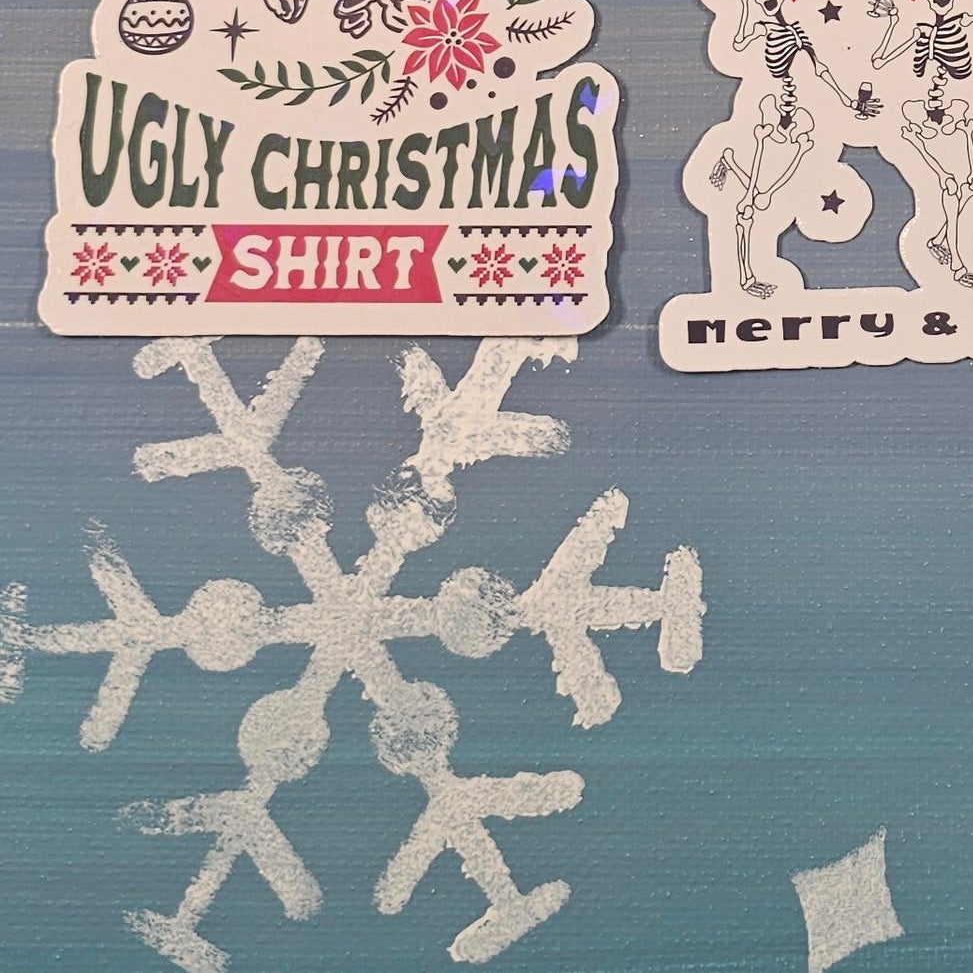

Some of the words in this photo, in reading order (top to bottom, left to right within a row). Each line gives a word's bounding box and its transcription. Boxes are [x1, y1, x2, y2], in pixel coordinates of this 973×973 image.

[80, 72, 234, 209] UGLY
[251, 76, 598, 211] CHRISTMAS
[229, 234, 425, 291] SHIRT
[687, 313, 895, 344] Merry
[922, 311, 958, 335] &
